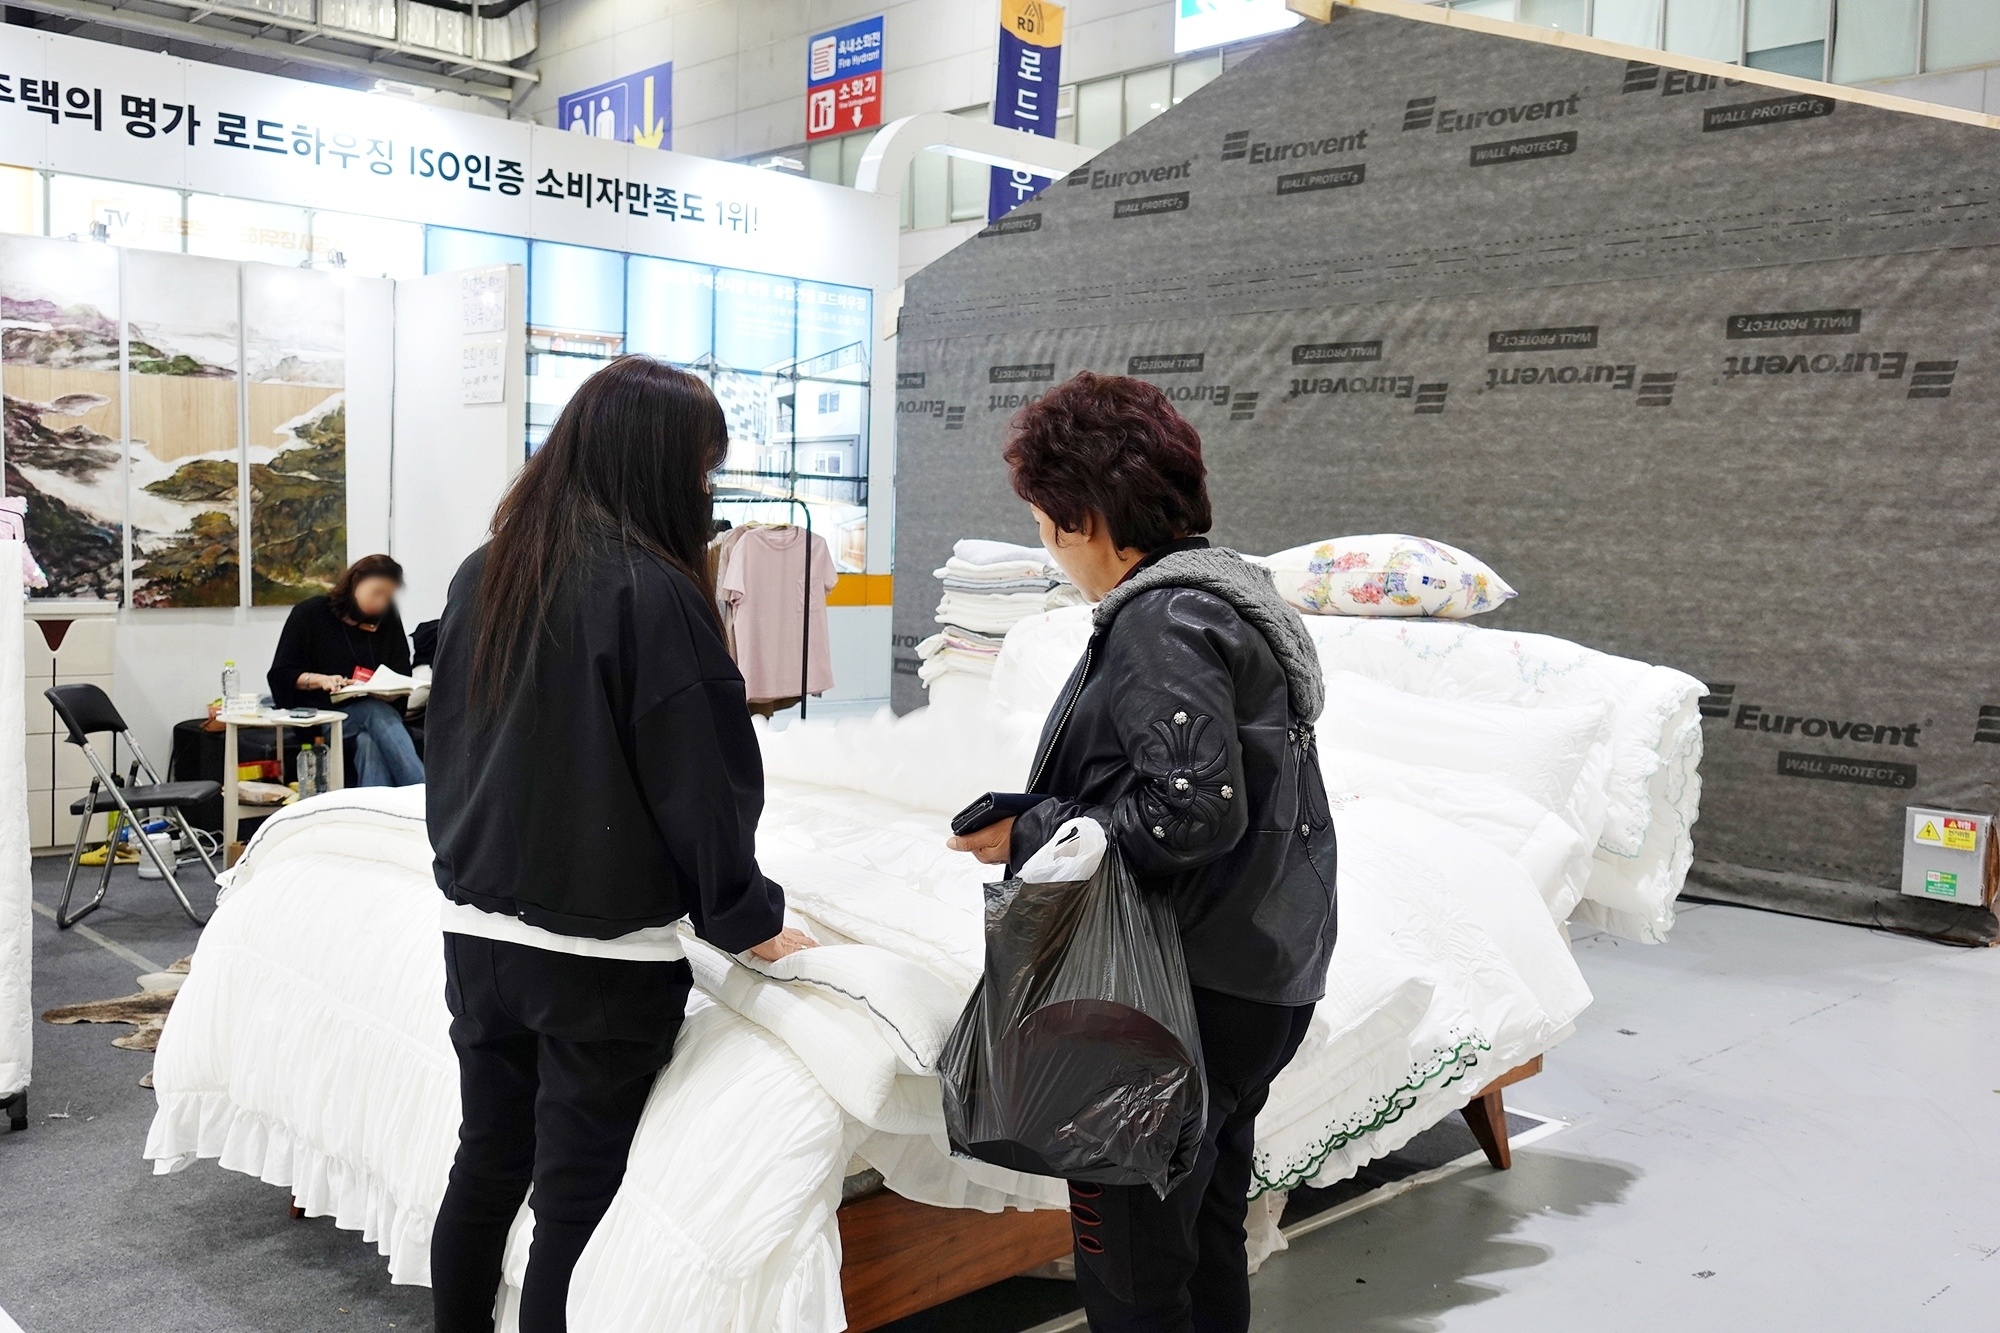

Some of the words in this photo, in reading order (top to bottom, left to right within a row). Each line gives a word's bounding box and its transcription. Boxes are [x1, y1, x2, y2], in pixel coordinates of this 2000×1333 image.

[1017, 17, 1034, 33] RD
[838, 76, 877, 101] 소화기
[1436, 91, 1581, 134] Eurovent
[1710, 110, 1748, 125] WALL
[1009, 49, 1042, 210] 로드우
[1249, 129, 1368, 165] Eurovent
[1476, 147, 1506, 161] WALL
[121, 94, 201, 146] 명가
[213, 112, 393, 175] 로드하우징
[410, 146, 525, 196] ISO인증
[535, 168, 705, 222] 소비자만족도
[715, 200, 758, 234] 1위!
[1091, 160, 1191, 190] Eurovent
[1281, 178, 1307, 189] WALL
[1117, 204, 1140, 214] WALL
[1814, 316, 1853, 329] WALL
[1559, 332, 1592, 343] WALL
[1350, 347, 1378, 357] WALL
[1486, 364, 1636, 390] Eurovent
[1722, 352, 1908, 381] Eurovent
[1289, 375, 1414, 399] Eurovent
[1734, 704, 1921, 748] Eurovent
[1786, 758, 1824, 773] WALL
